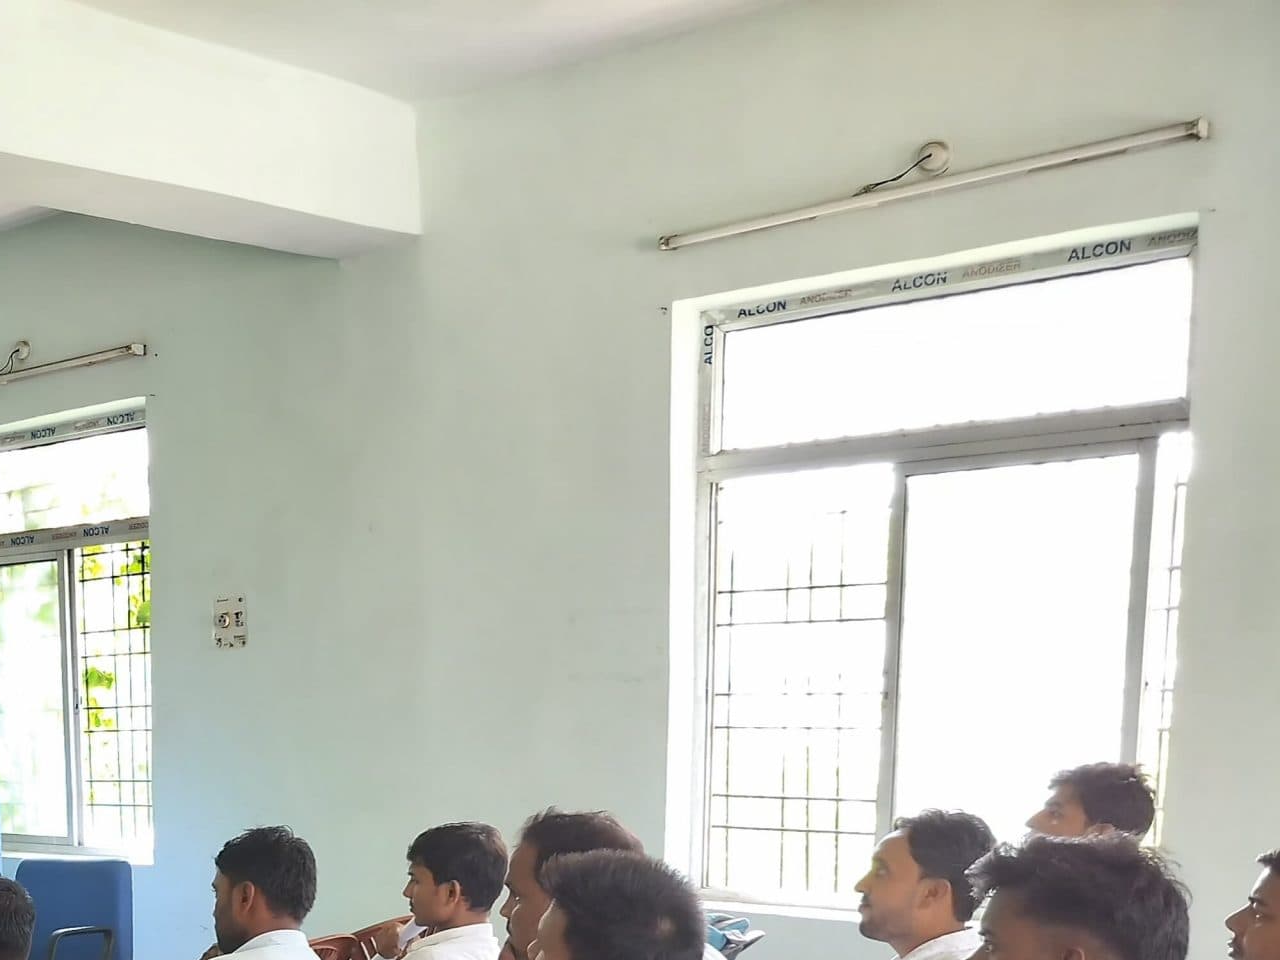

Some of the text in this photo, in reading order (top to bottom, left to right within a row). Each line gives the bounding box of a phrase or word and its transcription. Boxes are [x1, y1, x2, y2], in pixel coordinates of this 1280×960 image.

[737, 300, 787, 319] ALCON
[891, 272, 947, 292] ALCON
[1067, 239, 1132, 262] ALCON
[107, 411, 135, 425] ALCON
[30, 426, 56, 440] ALCON
[83, 525, 110, 537] ALCON
[10, 535, 35, 547] ALCON
